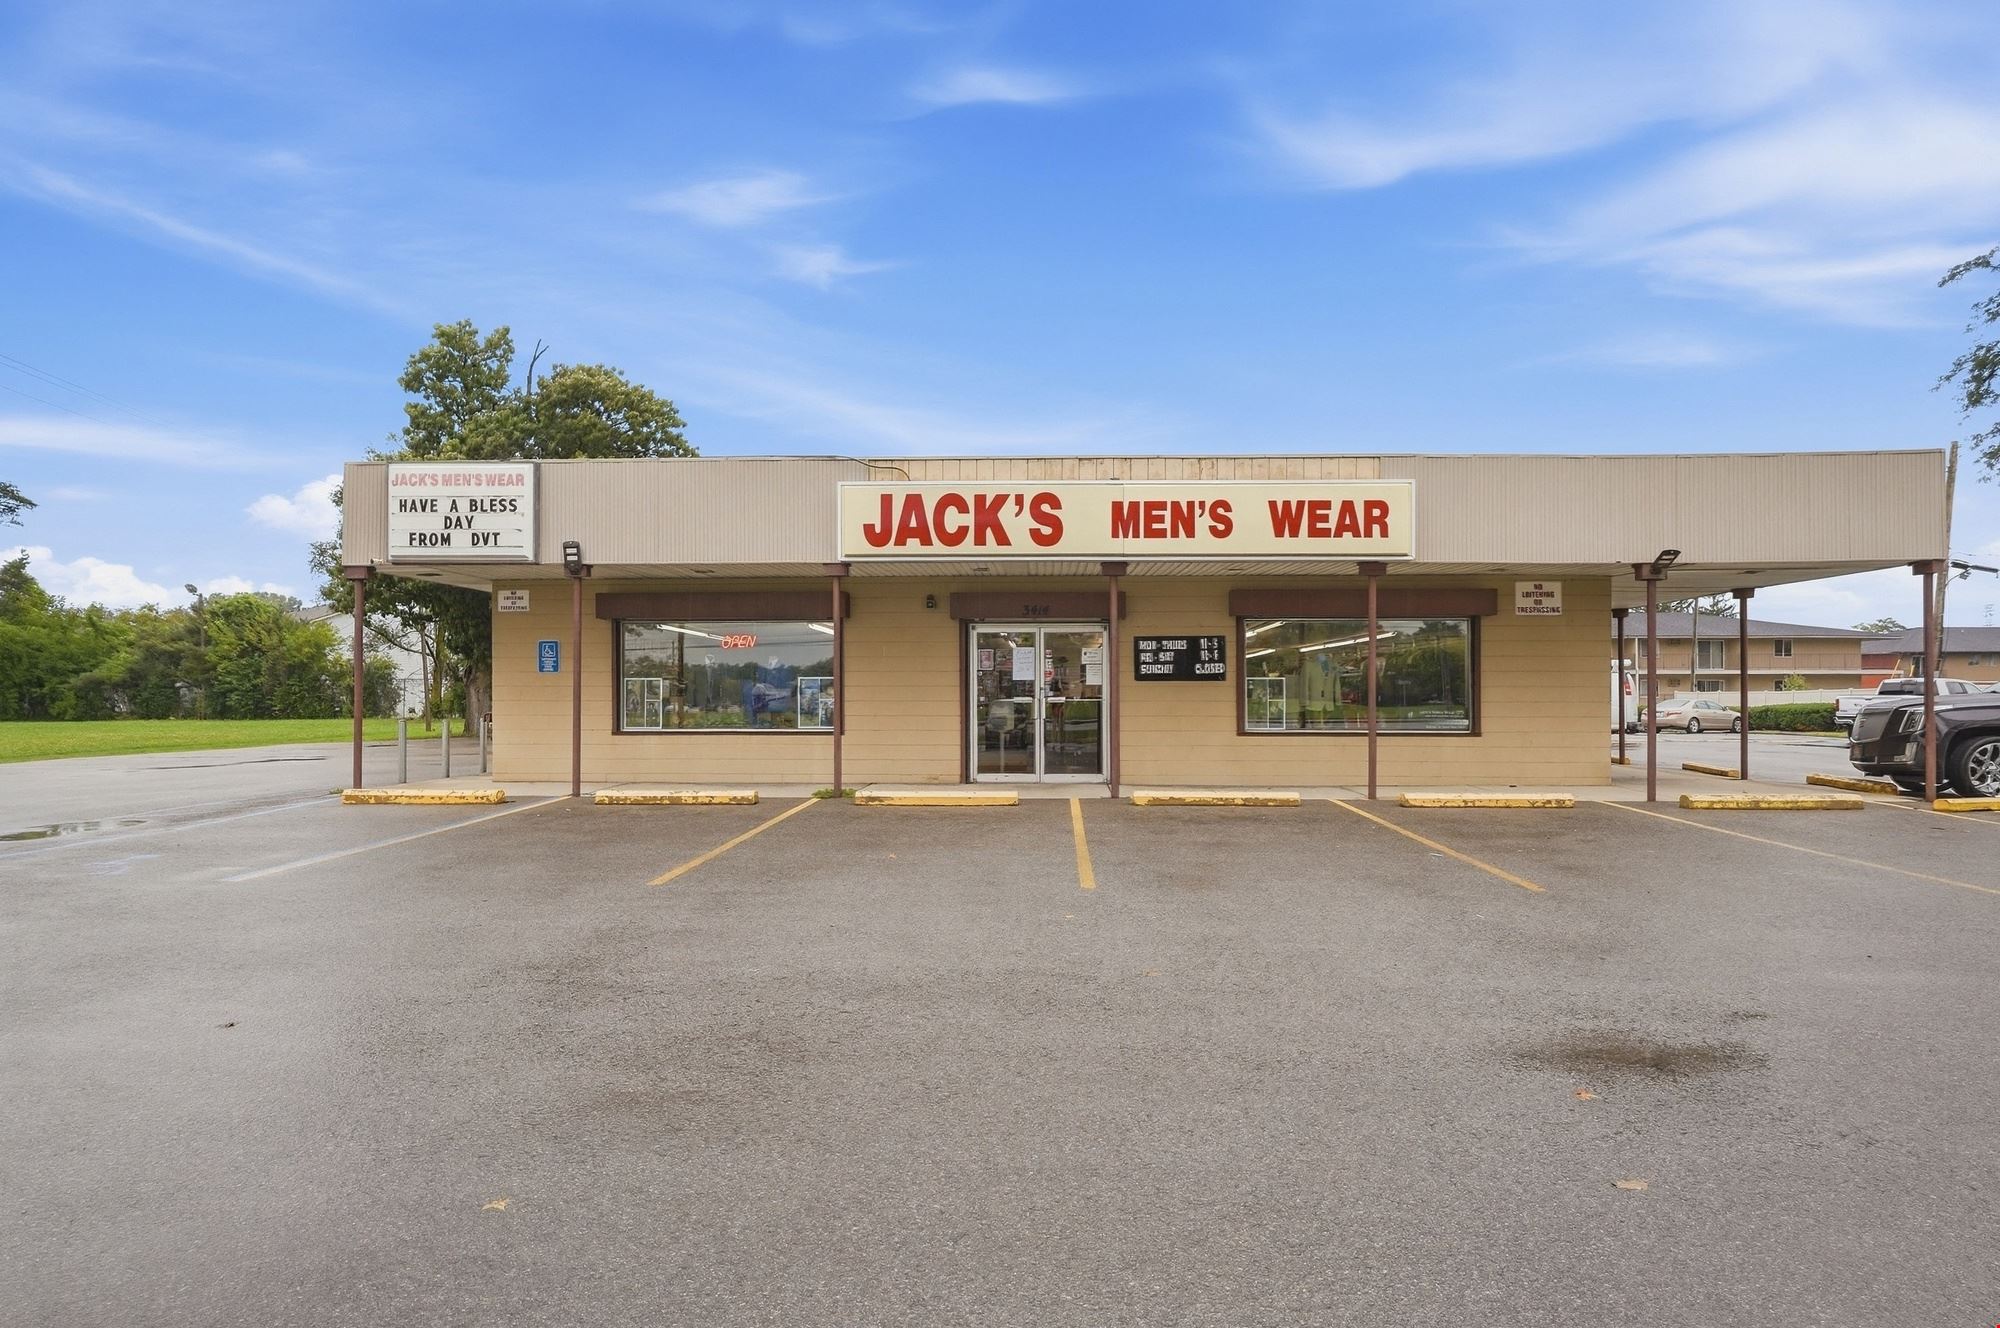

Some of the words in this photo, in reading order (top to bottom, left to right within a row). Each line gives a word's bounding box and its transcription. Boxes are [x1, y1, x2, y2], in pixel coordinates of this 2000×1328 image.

[391, 473, 439, 487] JACK'S
[441, 473, 483, 487] MEN'S
[484, 473, 525, 487] WEAR
[399, 498, 438, 513] HAVE
[449, 498, 459, 513] A
[469, 498, 518, 513] BLESS
[443, 515, 474, 530] DAY
[863, 492, 1064, 548] JACK'S
[1111, 499, 1233, 539] MEN'S
[1268, 499, 1390, 538] WEAR
[409, 532, 451, 547] FROM
[471, 532, 500, 546] DVT
[721, 634, 757, 649] OPEN
